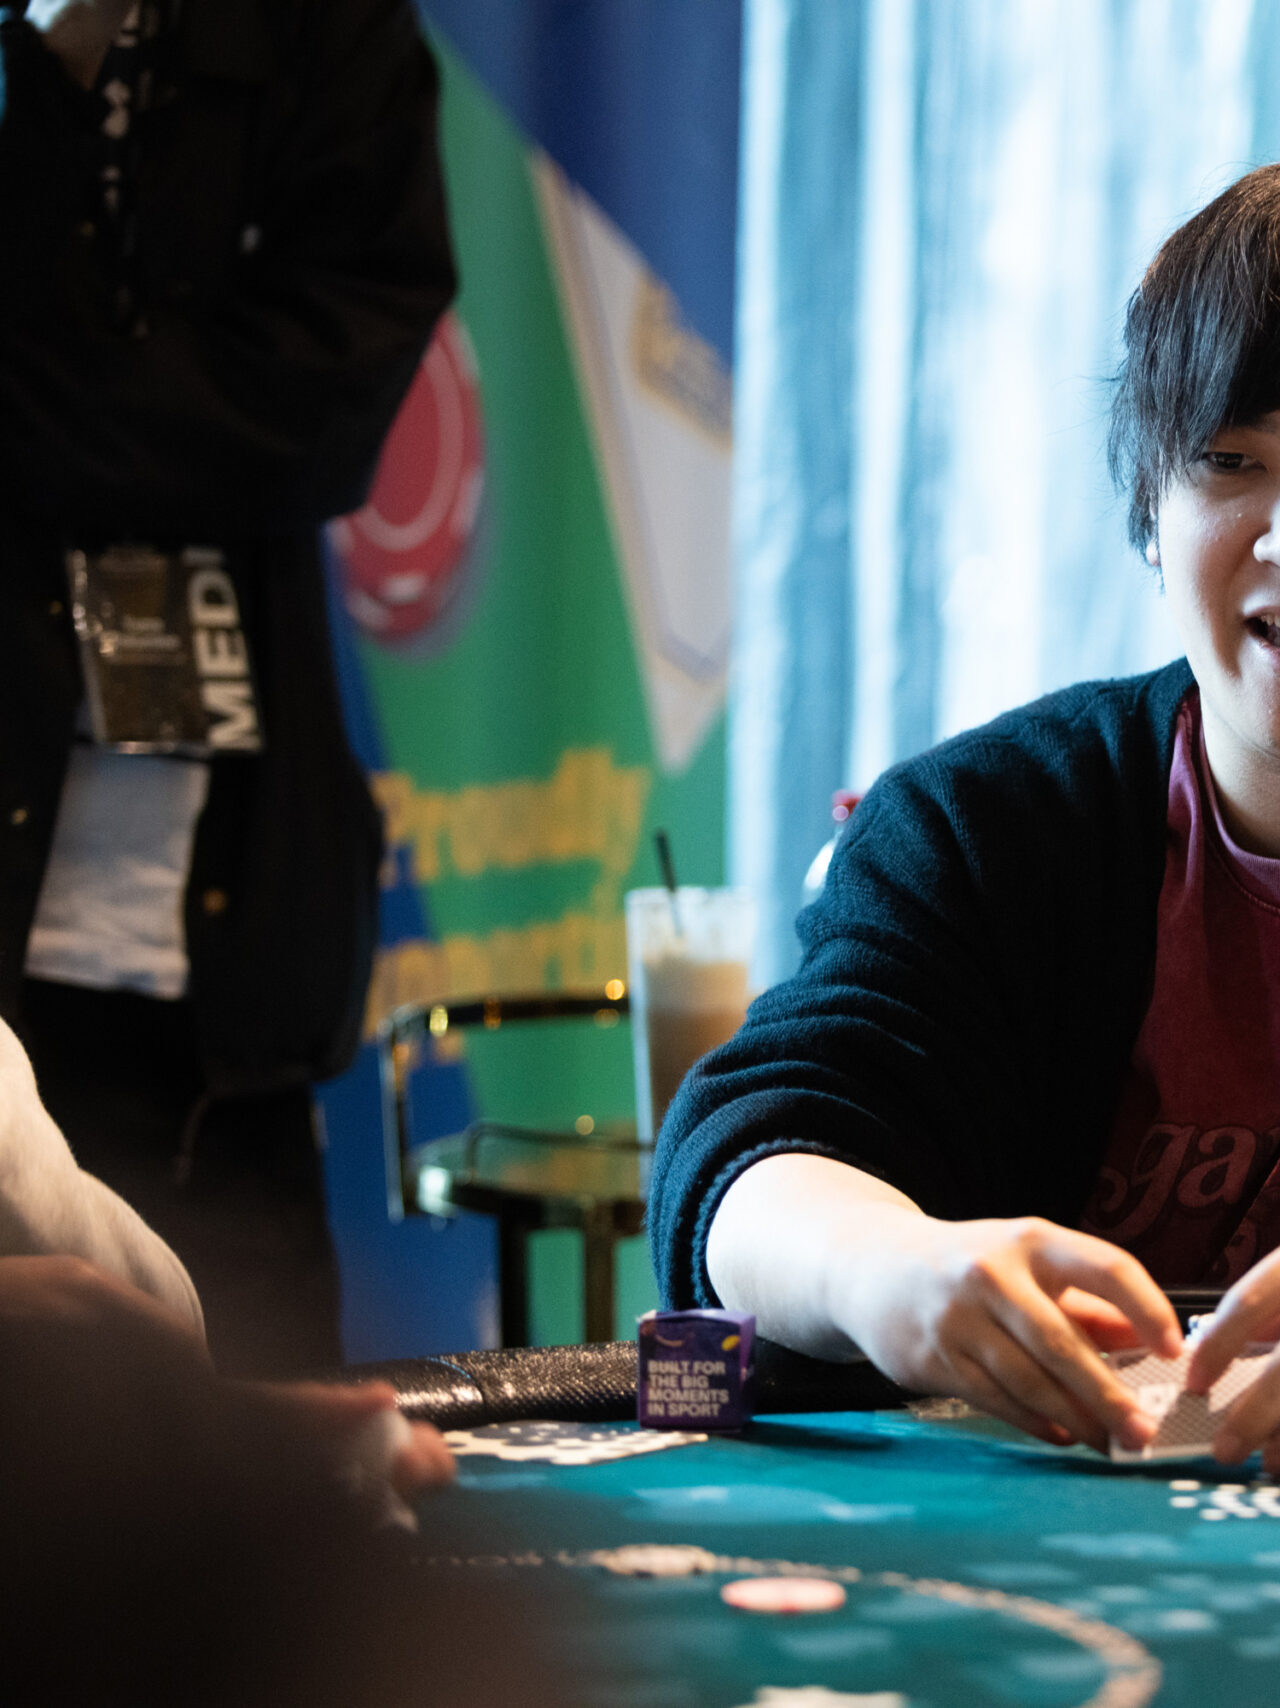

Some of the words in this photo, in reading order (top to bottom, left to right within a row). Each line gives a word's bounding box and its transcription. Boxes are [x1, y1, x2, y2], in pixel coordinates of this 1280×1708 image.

[184, 546, 261, 750] MEDI
[648, 1360, 690, 1374] BUILT
[692, 1361, 726, 1375] FOR
[649, 1375, 679, 1388] THE
[682, 1375, 709, 1388] BIG
[648, 1389, 729, 1404] MOMENTS
[647, 1403, 665, 1417] IN
[667, 1403, 721, 1417] SPORT
